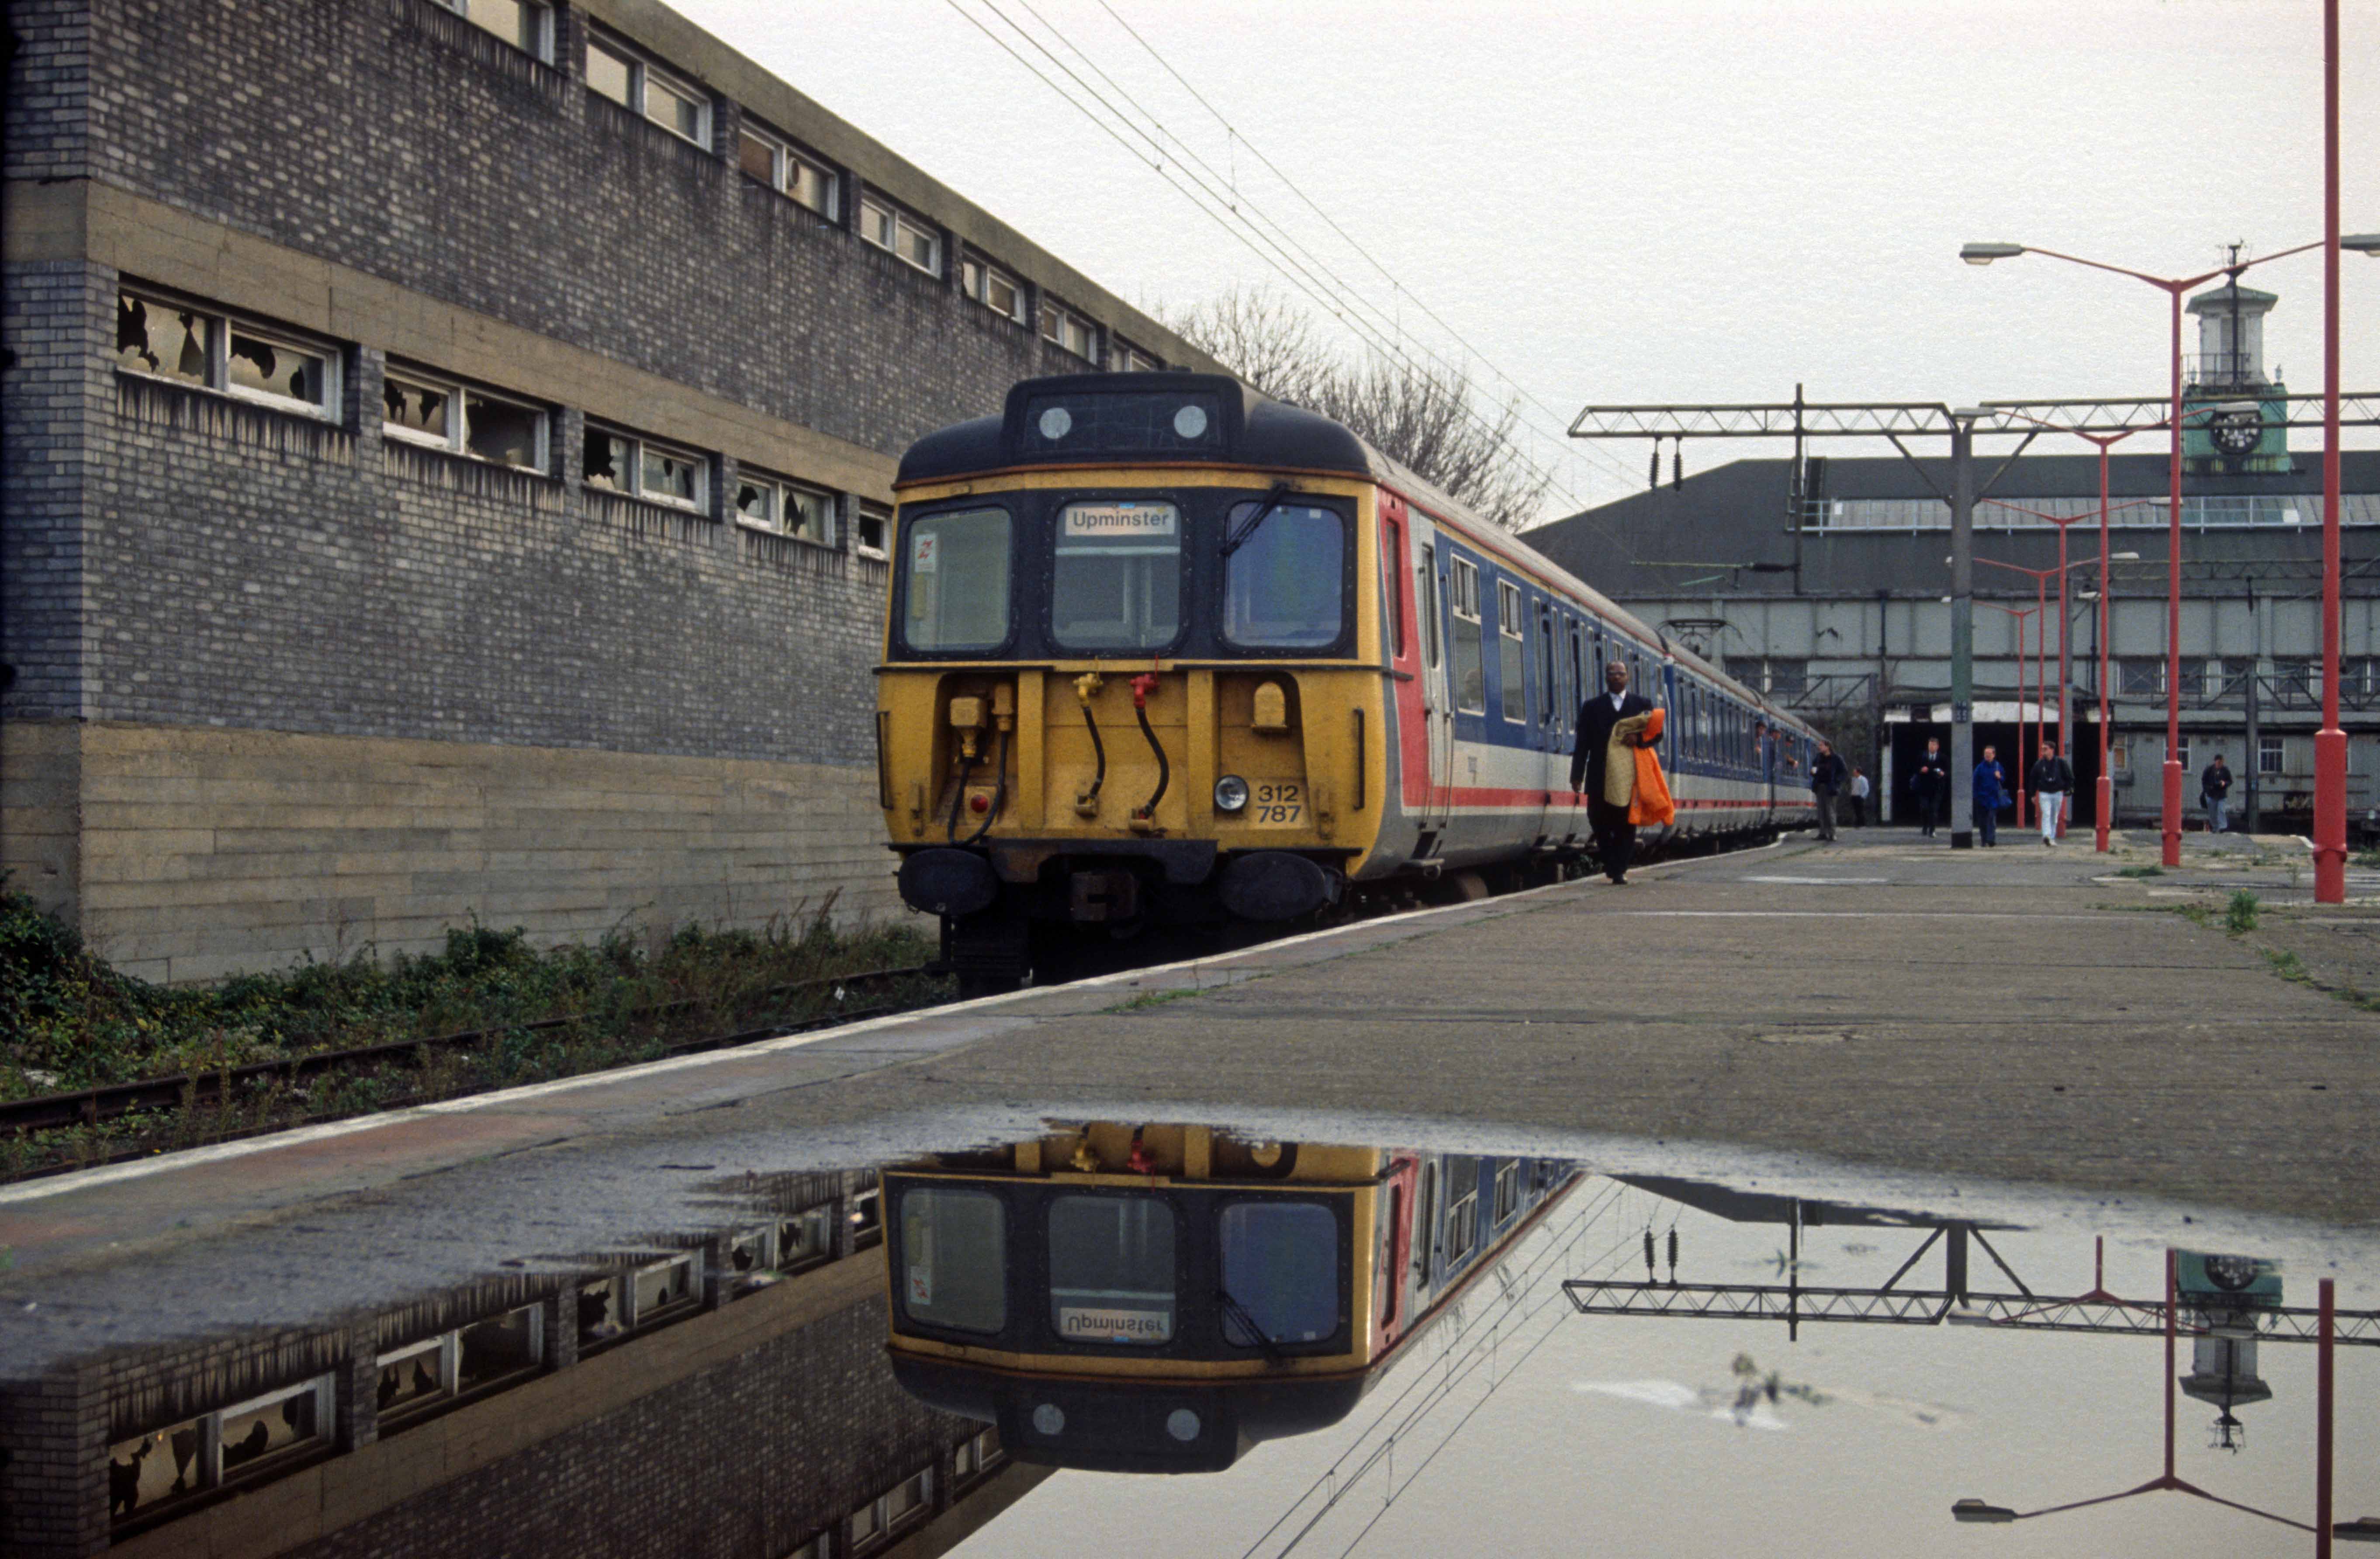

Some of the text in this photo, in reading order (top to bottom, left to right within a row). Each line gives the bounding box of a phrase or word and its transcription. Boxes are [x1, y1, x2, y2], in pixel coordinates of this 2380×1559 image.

[1073, 510, 1169, 530] Upminster
[1258, 785, 1298, 802] 312
[1257, 805, 1301, 823] 787
